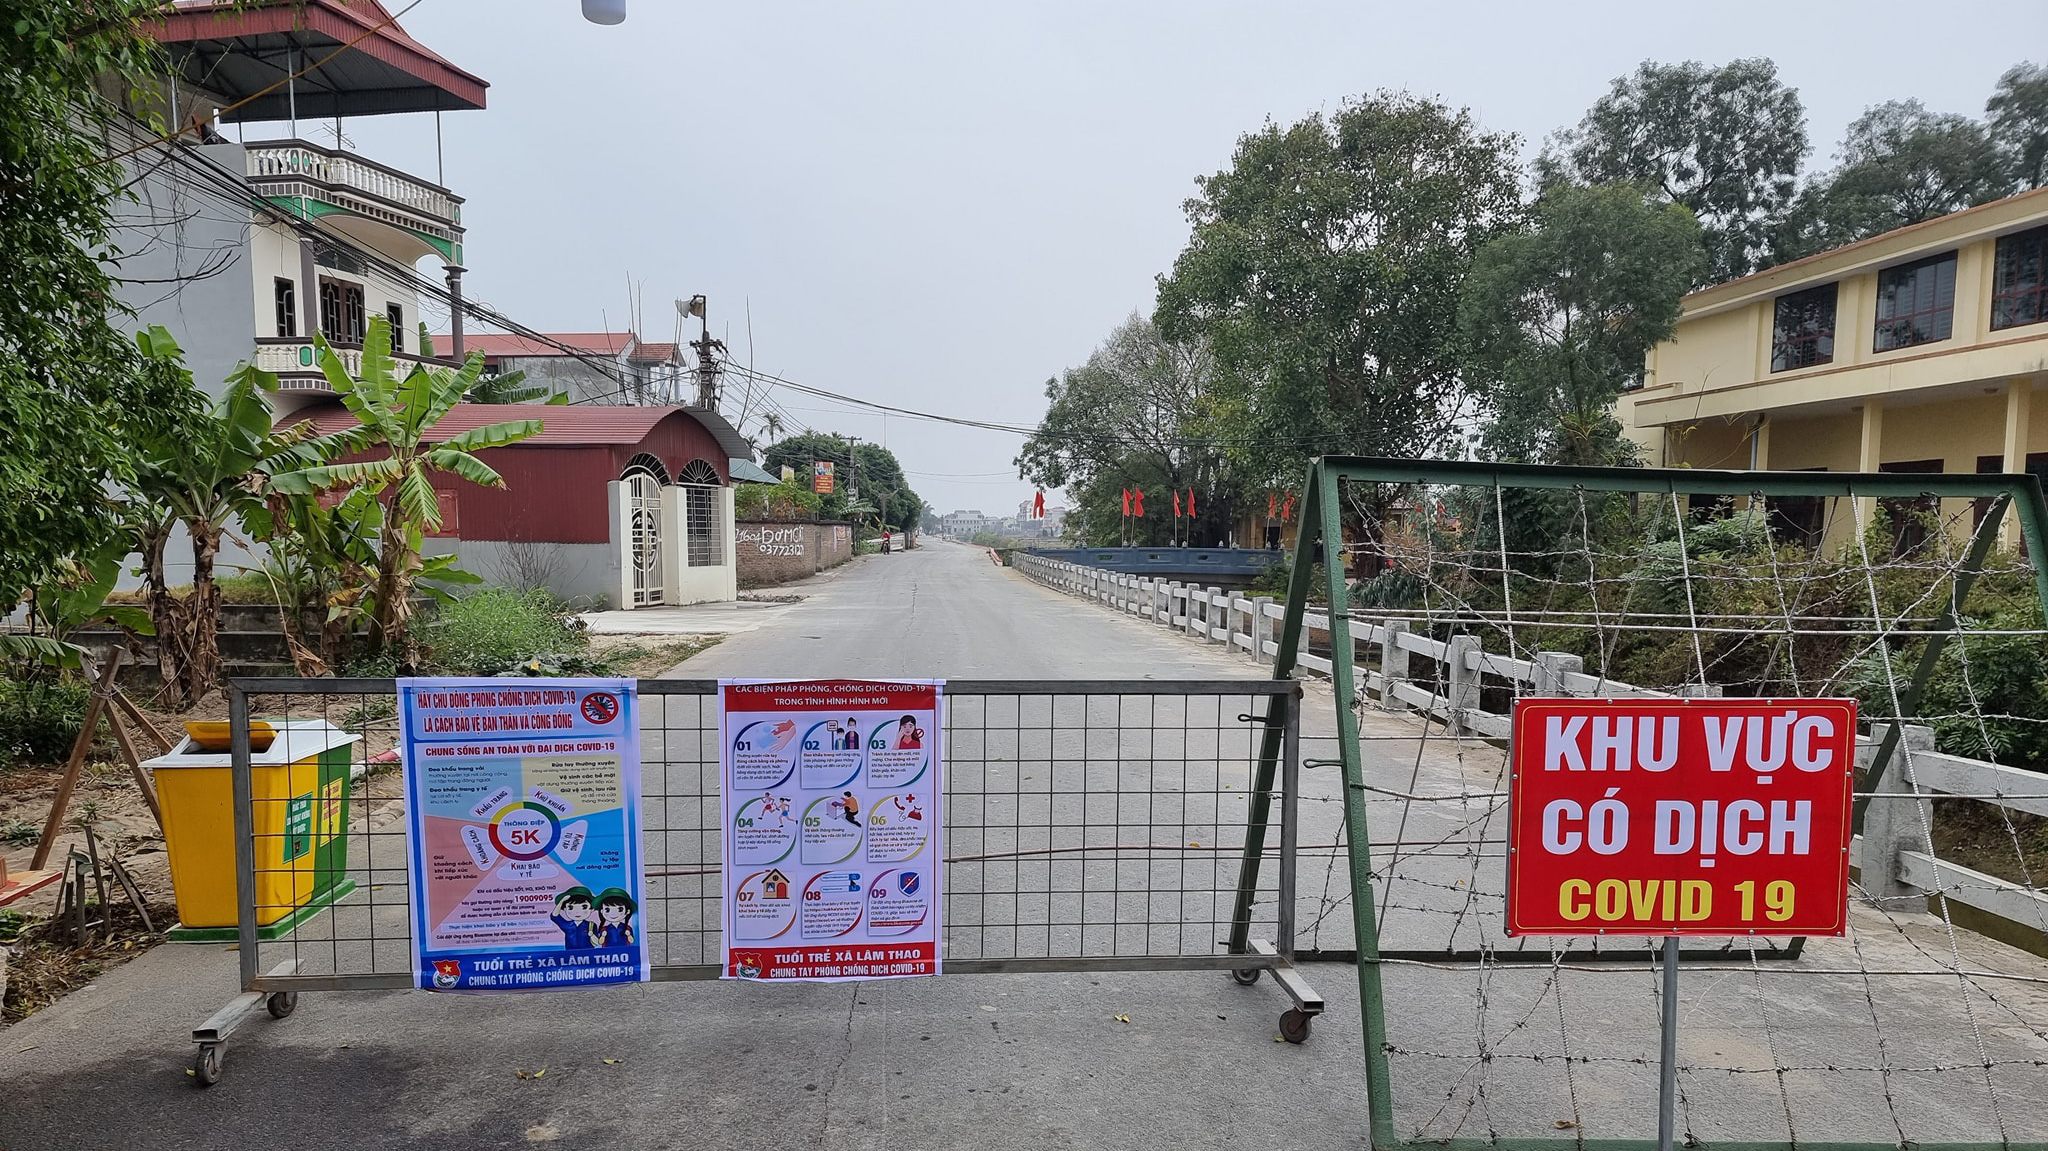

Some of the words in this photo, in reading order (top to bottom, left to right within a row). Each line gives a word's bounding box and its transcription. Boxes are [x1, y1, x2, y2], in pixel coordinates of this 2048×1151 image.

[735, 685, 753, 693] CÁC
[754, 685, 773, 694] BIỆN
[799, 685, 832, 693] PHÒNG,
[833, 684, 864, 692] CHỐNG
[865, 685, 886, 694] DỊCH
[417, 690, 431, 709] HÃY
[433, 687, 448, 708] CHỦ
[449, 690, 469, 711] ĐỘNG
[471, 689, 496, 707] PHÒNG
[498, 686, 522, 707] CHỐNG
[524, 691, 541, 709] DỊCH
[544, 690, 576, 706] COVID-19
[805, 697, 824, 705] TÌNH
[826, 697, 847, 705] HÌNH
[849, 697, 870, 705] HÌNH
[871, 696, 888, 704] MỚI
[424, 714, 433, 733] LÀ
[434, 715, 454, 732] CÁCH
[455, 711, 470, 732] BẢO
[471, 714, 481, 735] VỆ
[482, 710, 497, 731] BẢN
[499, 712, 518, 730] THÂN
[520, 712, 530, 730] VÀ
[531, 711, 551, 733] CỘNG
[552, 709, 573, 729] ĐỒNG
[425, 748, 454, 756] CHUNG
[457, 745, 480, 755] SỐNG
[483, 747, 495, 755] AN
[497, 744, 519, 754] TOÀN
[521, 744, 535, 753] VỚI
[538, 744, 552, 755] ĐẠI
[555, 744, 574, 754] DỊCH
[577, 742, 615, 751] COVID-19
[737, 741, 751, 751] 01
[804, 740, 820, 750] 02
[871, 740, 886, 750] 03
[1544, 716, 1679, 772] KHU
[1702, 710, 1834, 784] VỰC
[475, 802, 493, 816] KHẨU
[491, 790, 508, 806] TRANG
[534, 790, 549, 802] KHỬ
[547, 799, 566, 813] KHUẨN
[738, 818, 754, 828] 04
[805, 817, 821, 827] 05
[871, 816, 886, 825] 06
[1542, 787, 1630, 855] CÓ
[1653, 799, 1812, 868] DỊCH
[511, 829, 540, 845] 5K
[515, 894, 554, 902] 19009095
[739, 892, 755, 902] 07
[805, 891, 821, 901] 08
[872, 888, 886, 898] 09
[1559, 878, 1712, 921] COVID
[1733, 880, 1795, 921] 19
[473, 956, 504, 971] TUỔI
[508, 955, 533, 970] TRẺ
[538, 956, 556, 967] XÃ
[560, 955, 590, 966] LÂM
[594, 953, 629, 964] THAO
[774, 950, 804, 964] TUỔI
[808, 949, 831, 963] TRẺ
[835, 950, 853, 961] XÃ
[856, 950, 884, 961] LÂM
[888, 949, 920, 960] THAO
[469, 976, 496, 986] CHUNG
[498, 974, 514, 985] TAY
[516, 970, 544, 983] PHÒNG
[546, 967, 574, 981] CHỐNG
[576, 968, 595, 982] DỊCH
[597, 966, 634, 978] COVID-19
[770, 968, 796, 978] CHUNG
[798, 967, 812, 977] TAY
[814, 964, 840, 976] PHÒNG
[843, 962, 869, 975] CHỐNG
[871, 964, 888, 976] DỊCH
[890, 963, 925, 973] COVID-19
